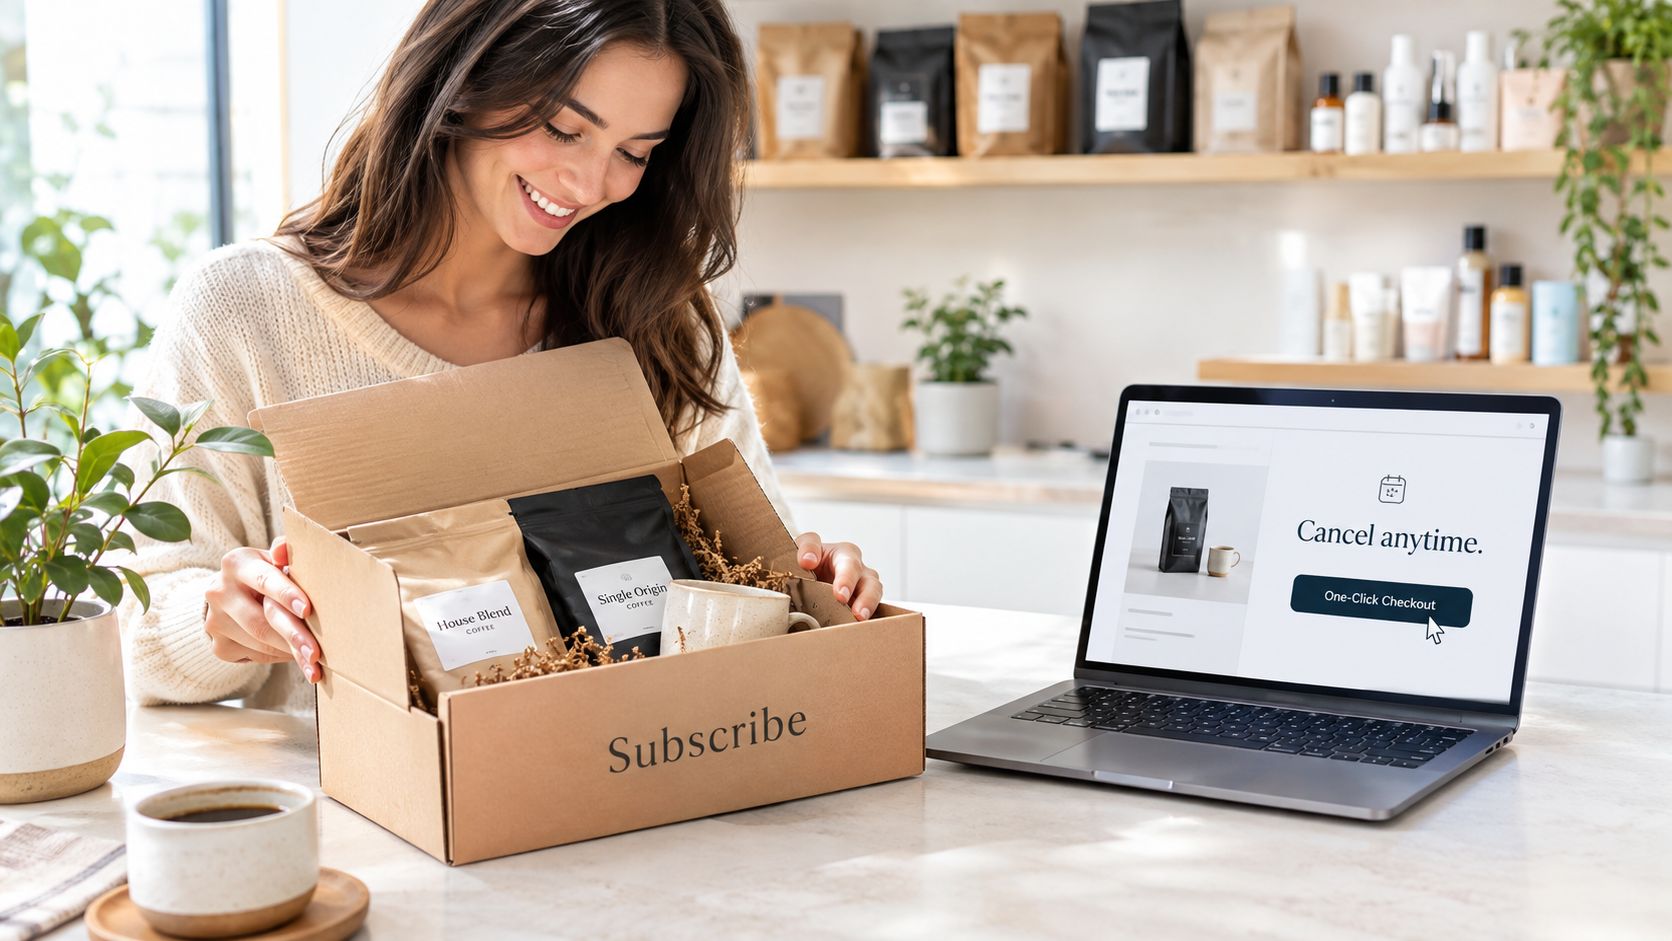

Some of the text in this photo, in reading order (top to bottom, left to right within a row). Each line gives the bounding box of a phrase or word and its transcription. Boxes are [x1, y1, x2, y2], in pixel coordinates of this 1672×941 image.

[1297, 519, 1483, 556] Cancel anytime.
[597, 583, 668, 605] Single Origin
[626, 600, 654, 610] COFFEE
[1324, 590, 1437, 611] One-Click Checkout
[437, 605, 512, 631] House Blend
[465, 624, 495, 635] COFFEE
[608, 706, 806, 774] Subscribe
